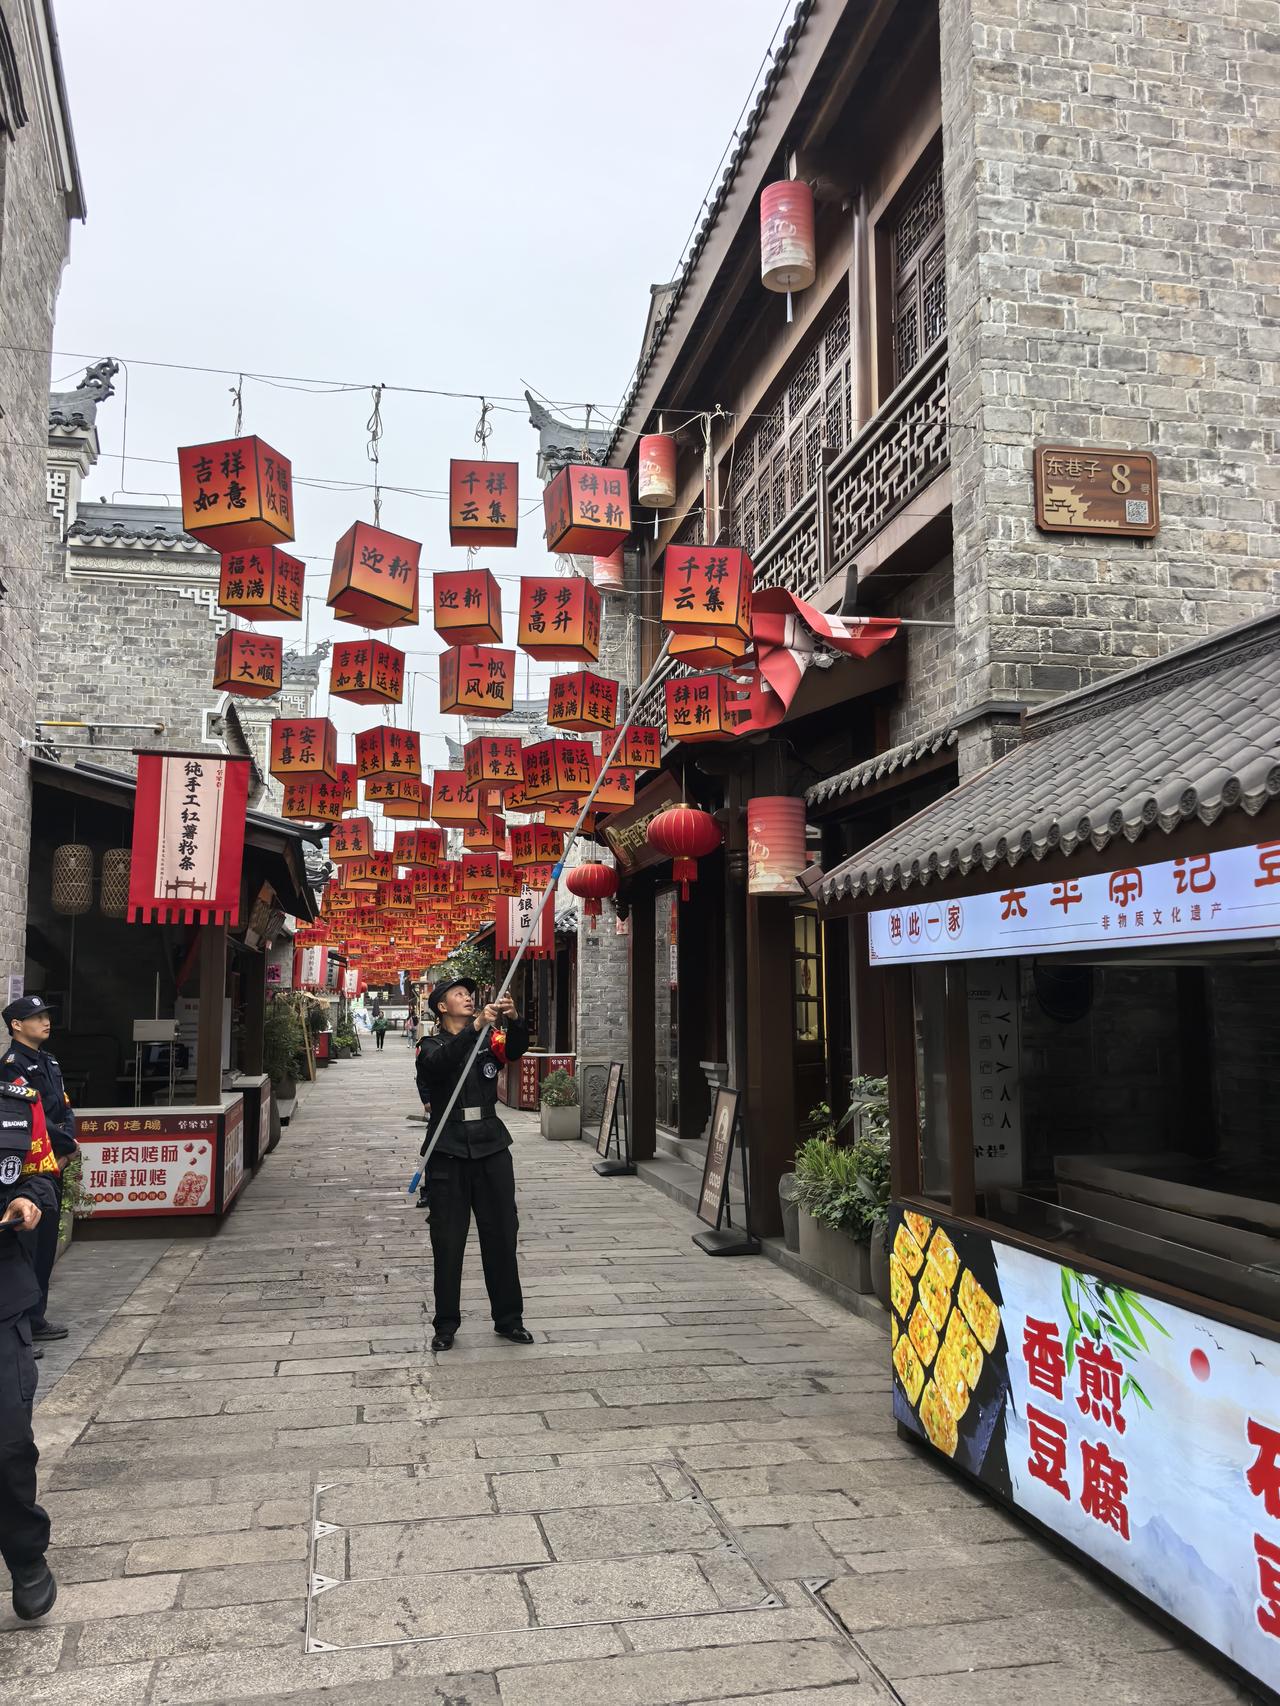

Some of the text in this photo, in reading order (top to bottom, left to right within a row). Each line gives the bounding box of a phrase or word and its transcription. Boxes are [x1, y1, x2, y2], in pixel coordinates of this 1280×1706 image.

[193, 449, 247, 484] 吉祥
[264, 457, 289, 492] 万福
[1045, 456, 1151, 496] 东巷子 8 号
[460, 471, 508, 495] 千祥
[578, 473, 622, 497] 辞旧
[193, 481, 247, 512] 如意
[459, 500, 507, 524] 云集
[579, 501, 624, 527] 迎新
[228, 554, 265, 576] 福气
[278, 559, 301, 588] 好运
[359, 545, 412, 585] 迎新
[677, 556, 729, 585] 千祥
[226, 578, 265, 601] 满满
[277, 584, 300, 612] 连连
[439, 586, 483, 610] 迎新
[530, 586, 573, 610] 步步
[674, 585, 725, 613] 云集
[528, 610, 573, 634] 高升
[239, 639, 275, 660] 六六
[339, 648, 368, 667] 吉祥
[378, 652, 400, 673] 时来
[467, 656, 507, 679] 一帆
[336, 670, 366, 688] 如意
[376, 671, 400, 695] 运转
[465, 678, 506, 701] 风顺
[553, 681, 578, 700] 福气
[589, 681, 613, 703] 好运
[673, 685, 710, 704] 辞旧
[552, 699, 577, 720] 满满
[587, 701, 612, 724] 连连
[674, 705, 712, 726] 迎新
[280, 726, 317, 745] 平安
[390, 731, 415, 750] 新春
[631, 731, 655, 746] 五福
[278, 745, 316, 764] 喜乐
[487, 741, 517, 758] 喜乐
[526, 750, 550, 770] 纳福
[561, 747, 590, 768] 福运
[631, 748, 655, 765] 临门
[489, 759, 518, 777] 常在
[527, 770, 552, 789] 迎祥
[564, 767, 591, 785] 临门
[438, 785, 475, 803] 无忧
[178, 761, 203, 871] 纯手工红薯粉条
[317, 801, 340, 817] 景明
[890, 905, 961, 938] 独此一家
[1101, 902, 1223, 930] 非物质文化遗产
[101, 1145, 178, 1165] 鲜肉烤肠
[90, 1168, 168, 1188] 现灌现烤
[1022, 1314, 1127, 1435] 香煎
[1027, 1402, 1131, 1541] 豆腐
